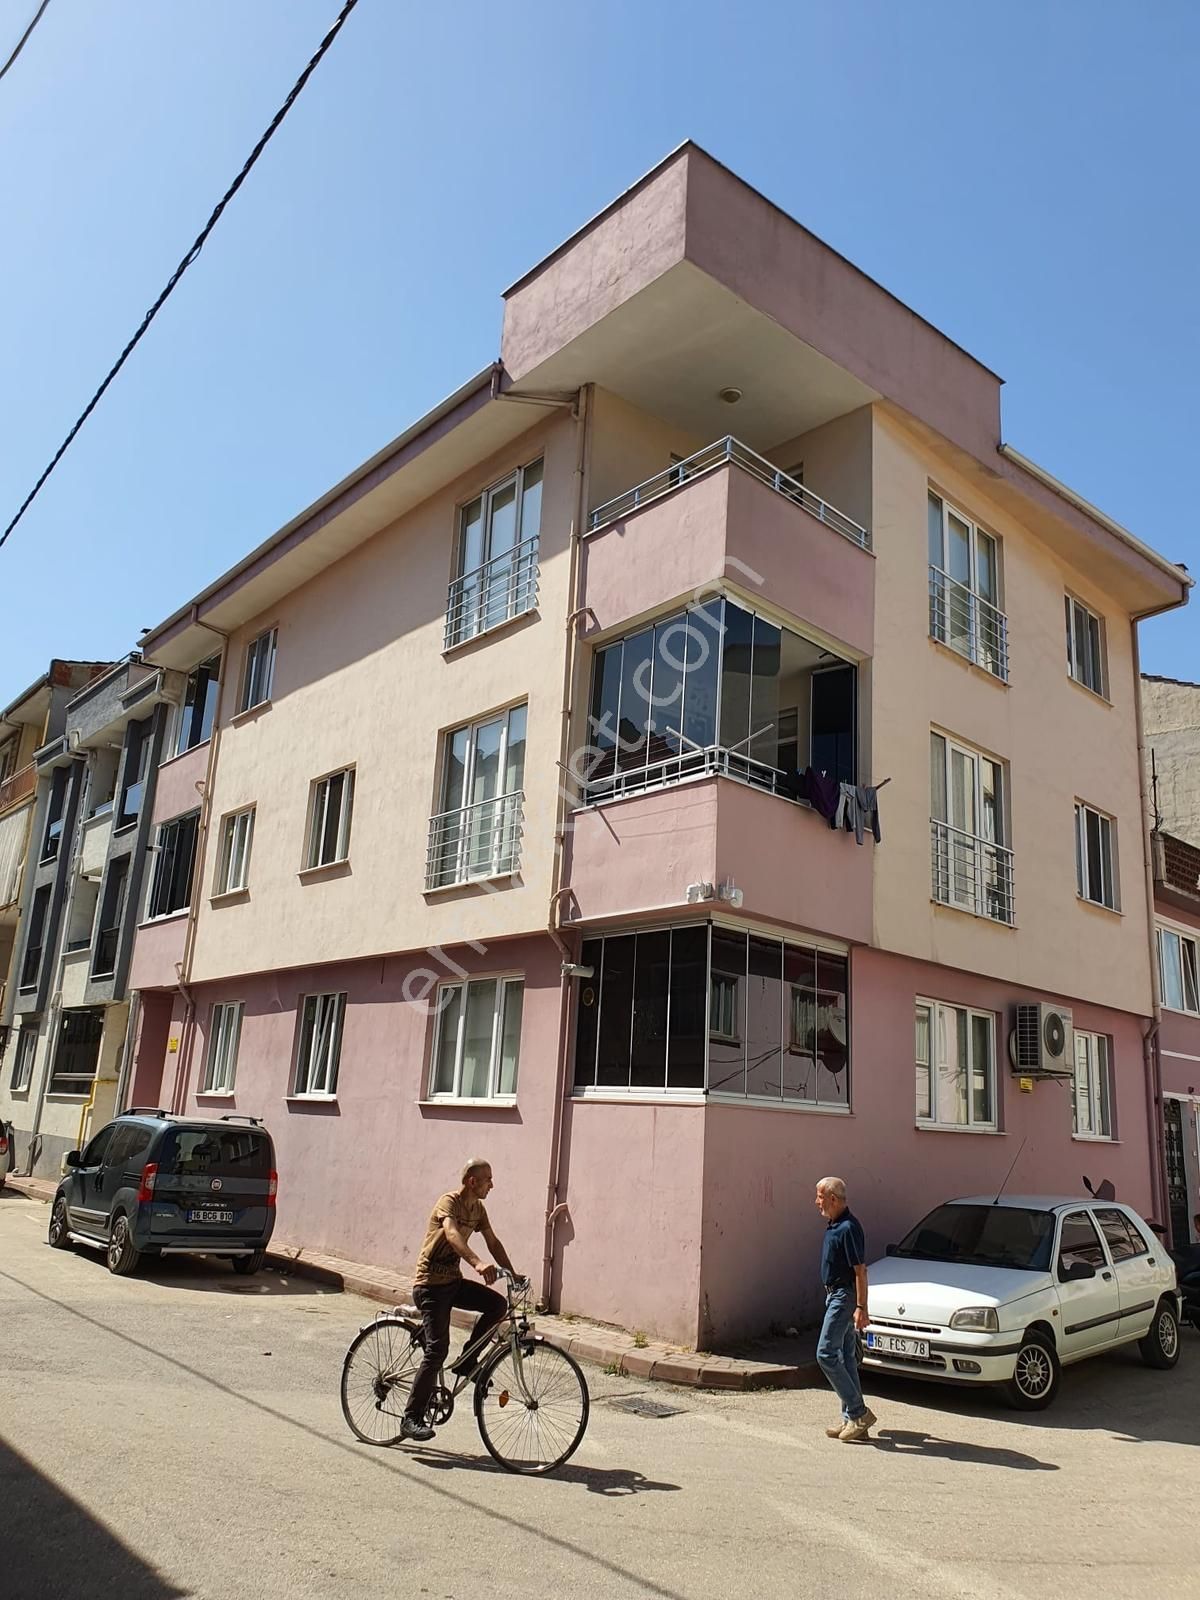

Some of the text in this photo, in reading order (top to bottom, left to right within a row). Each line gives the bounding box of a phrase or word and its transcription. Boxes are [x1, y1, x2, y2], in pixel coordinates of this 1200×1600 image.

[874, 1335, 926, 1355] 16 FCS 78
